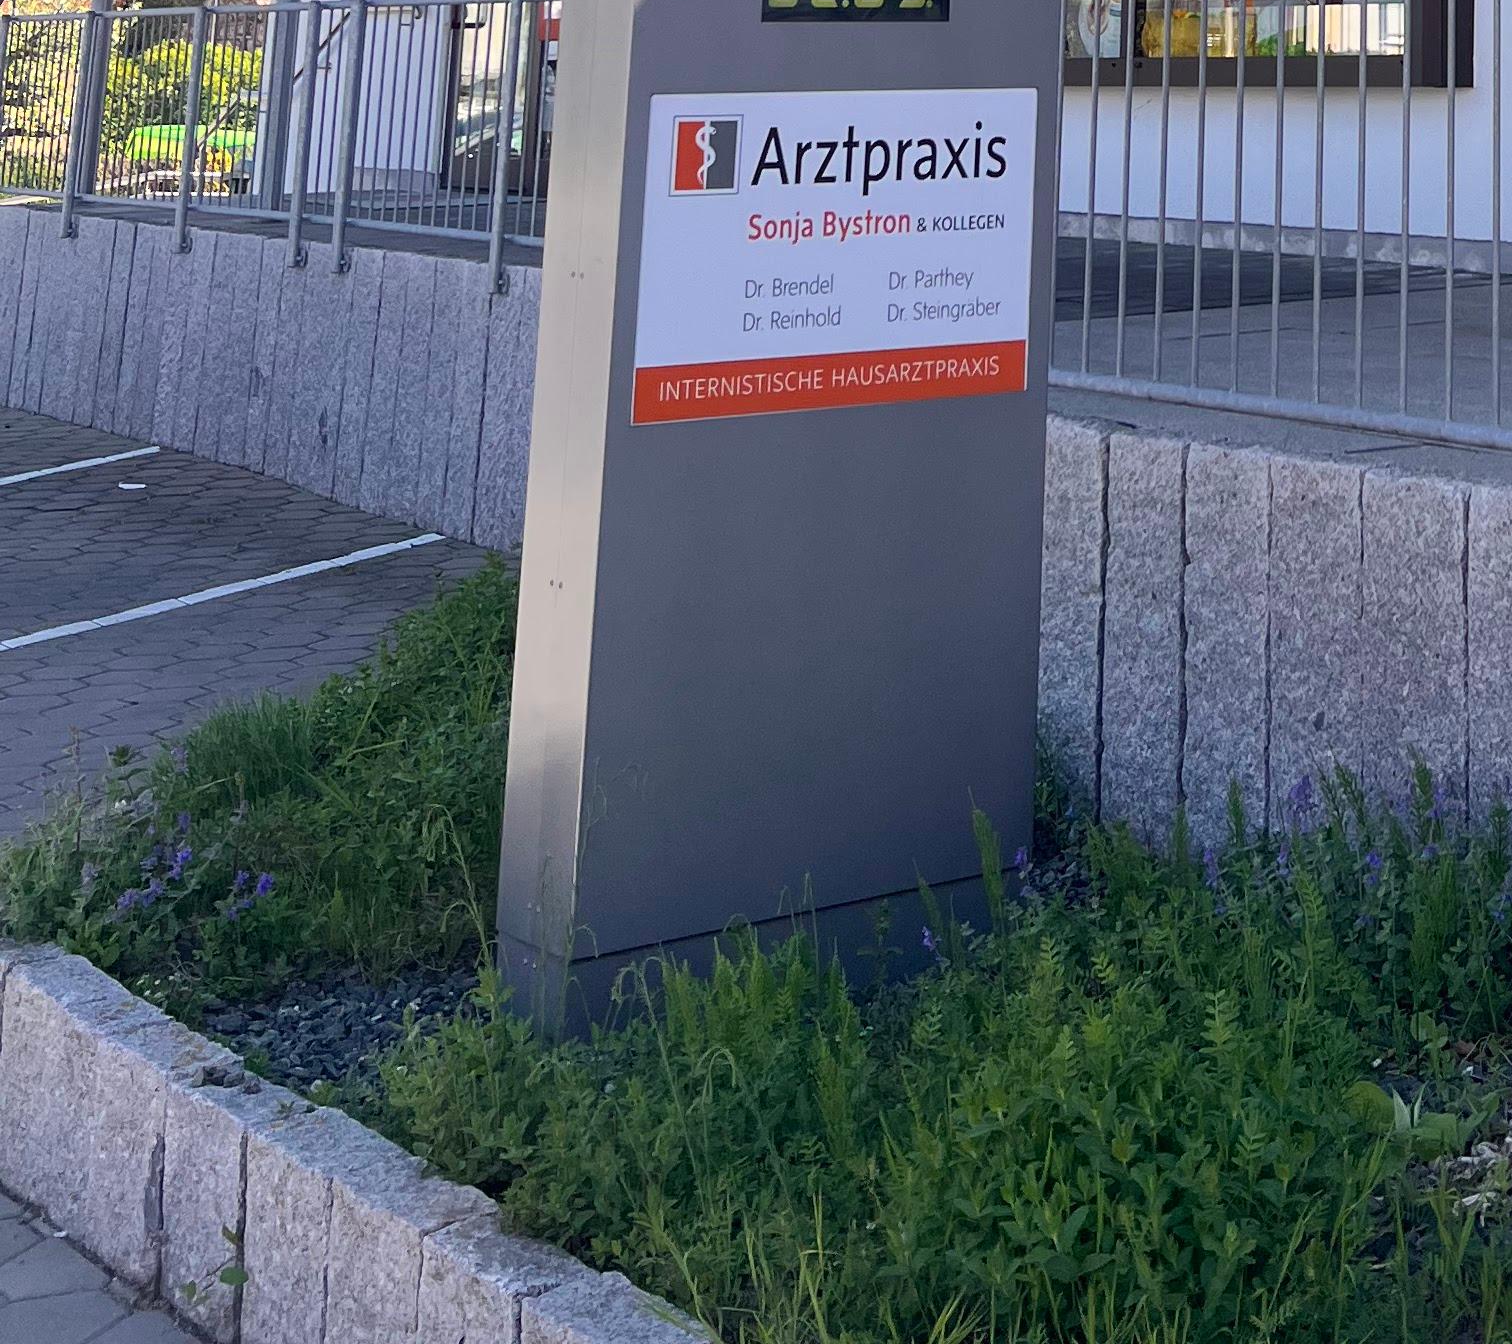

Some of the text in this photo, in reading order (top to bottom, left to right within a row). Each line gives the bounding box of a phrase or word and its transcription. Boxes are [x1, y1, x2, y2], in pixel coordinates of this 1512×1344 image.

[750, 121, 1008, 196] Arztpraxis
[748, 209, 1005, 245] Sonja Bystron & KOLLEGEN
[772, 273, 834, 297] Brendel
[914, 267, 974, 291] Parthey
[770, 305, 841, 330] Reinhold
[658, 354, 1000, 403] INTERNISTISCHE HAUSARZTPRAXIS
